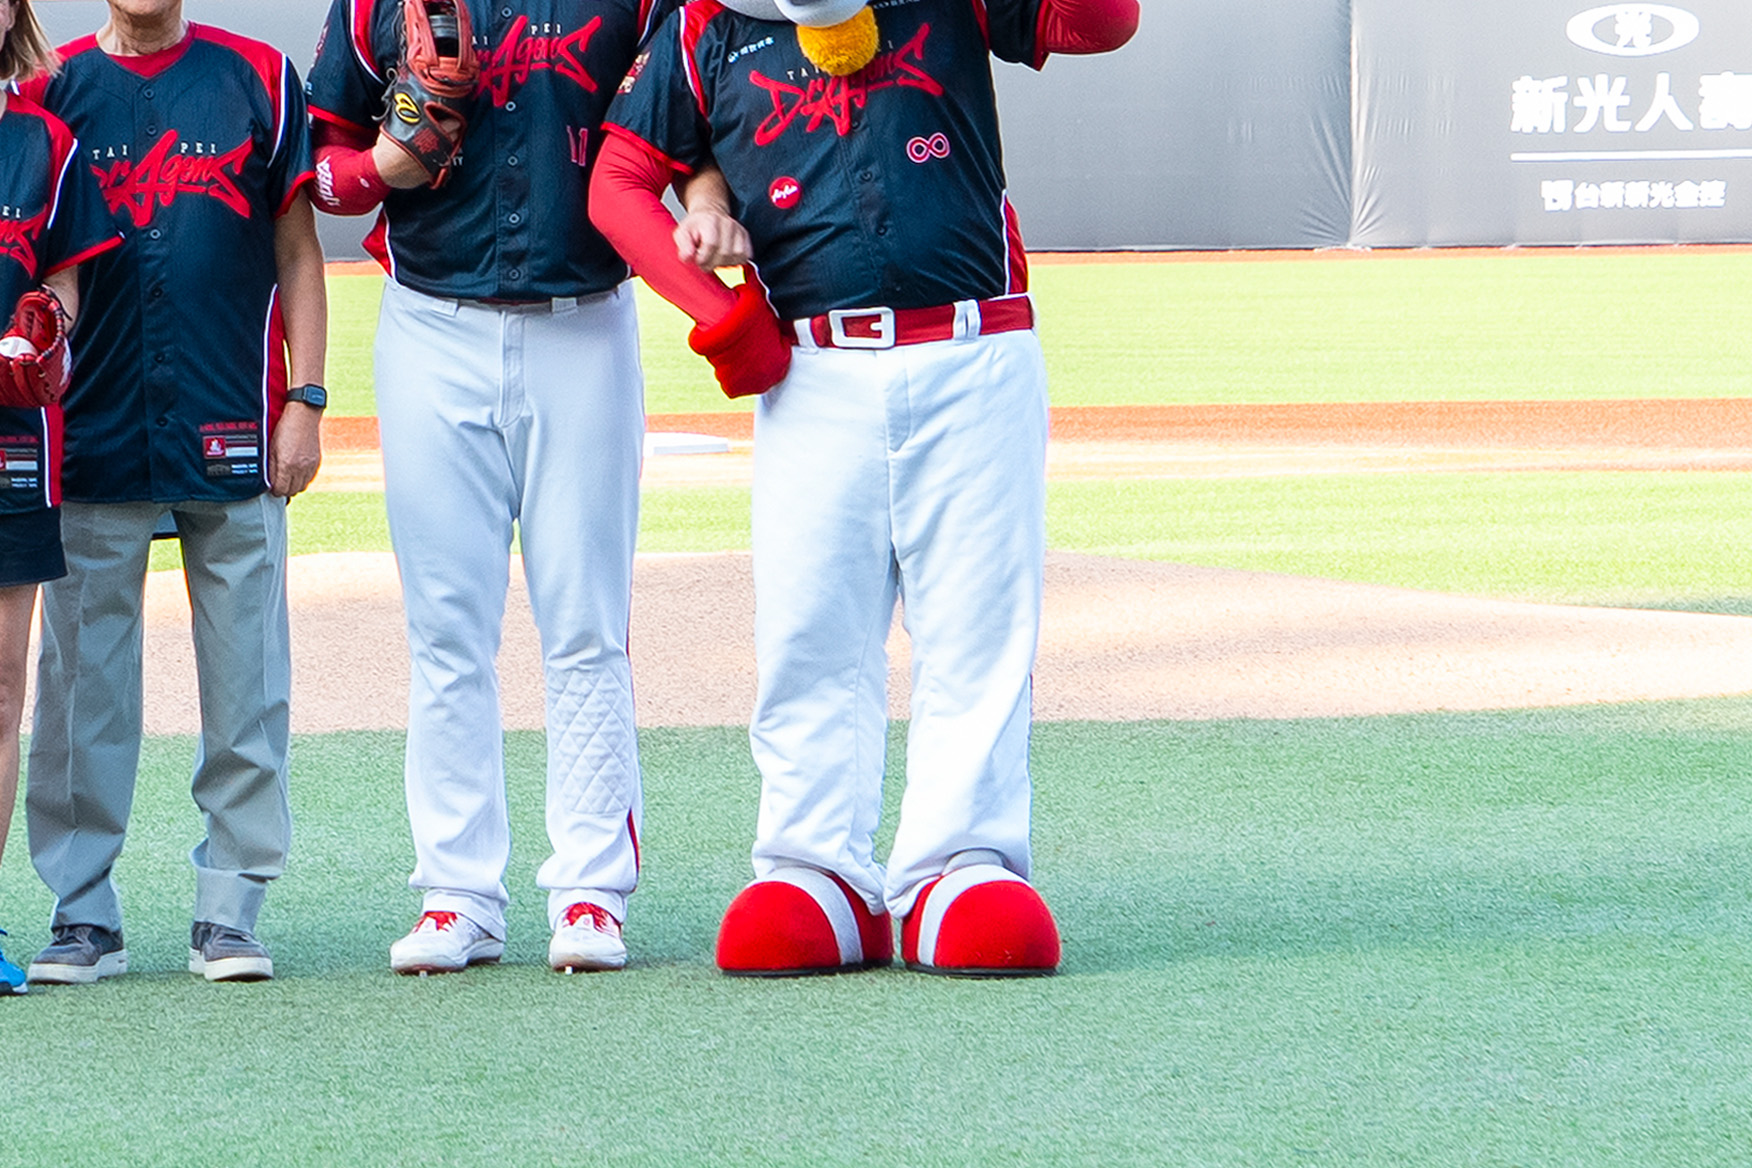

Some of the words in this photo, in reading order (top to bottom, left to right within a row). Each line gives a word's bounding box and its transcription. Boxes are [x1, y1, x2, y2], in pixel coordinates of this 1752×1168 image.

[1511, 72, 1752, 133] 新光人壽
[92, 144, 128, 160] TAI
[180, 141, 217, 154] PEI
